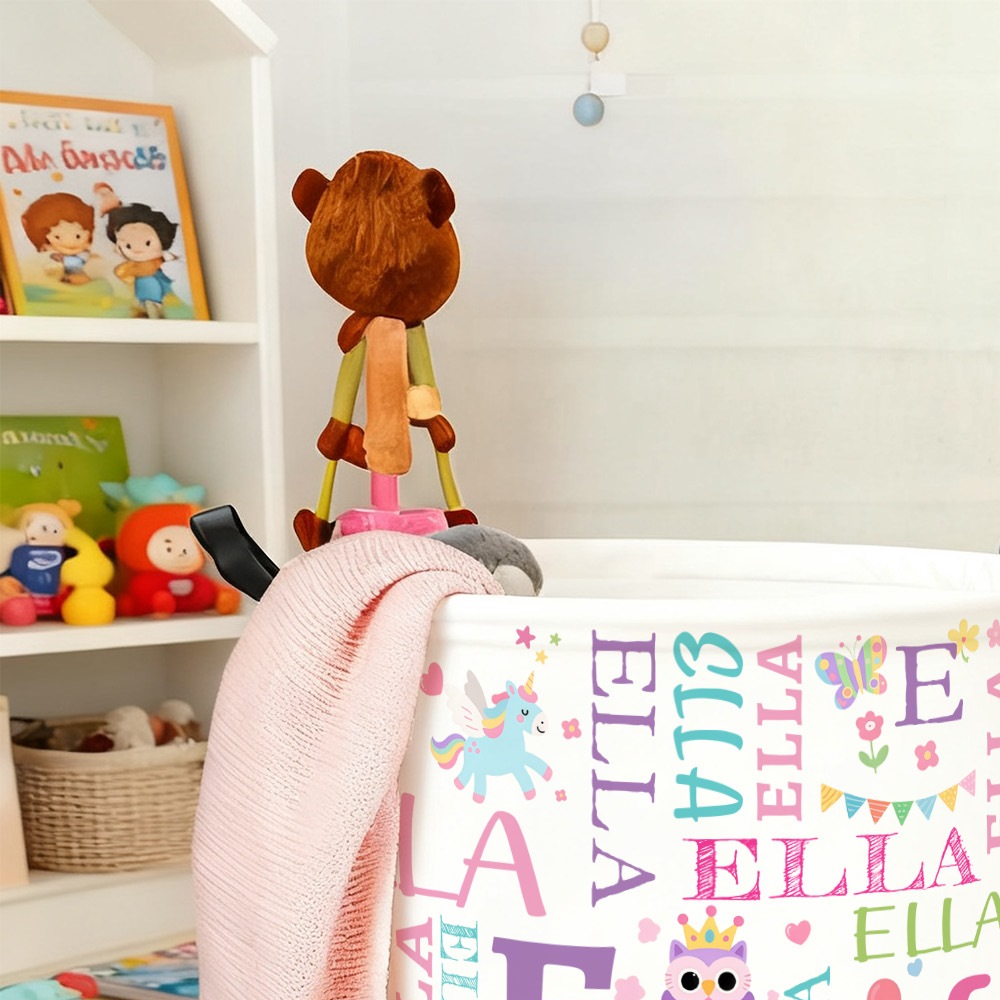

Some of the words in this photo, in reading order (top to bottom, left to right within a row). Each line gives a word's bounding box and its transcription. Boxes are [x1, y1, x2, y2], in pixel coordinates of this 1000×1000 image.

[673, 632, 743, 822] ELLA
[757, 635, 802, 821] ELLA
[895, 643, 963, 727] E
[592, 629, 655, 908] ELLA
[398, 793, 546, 917] LA
[682, 826, 981, 901] ELLA
